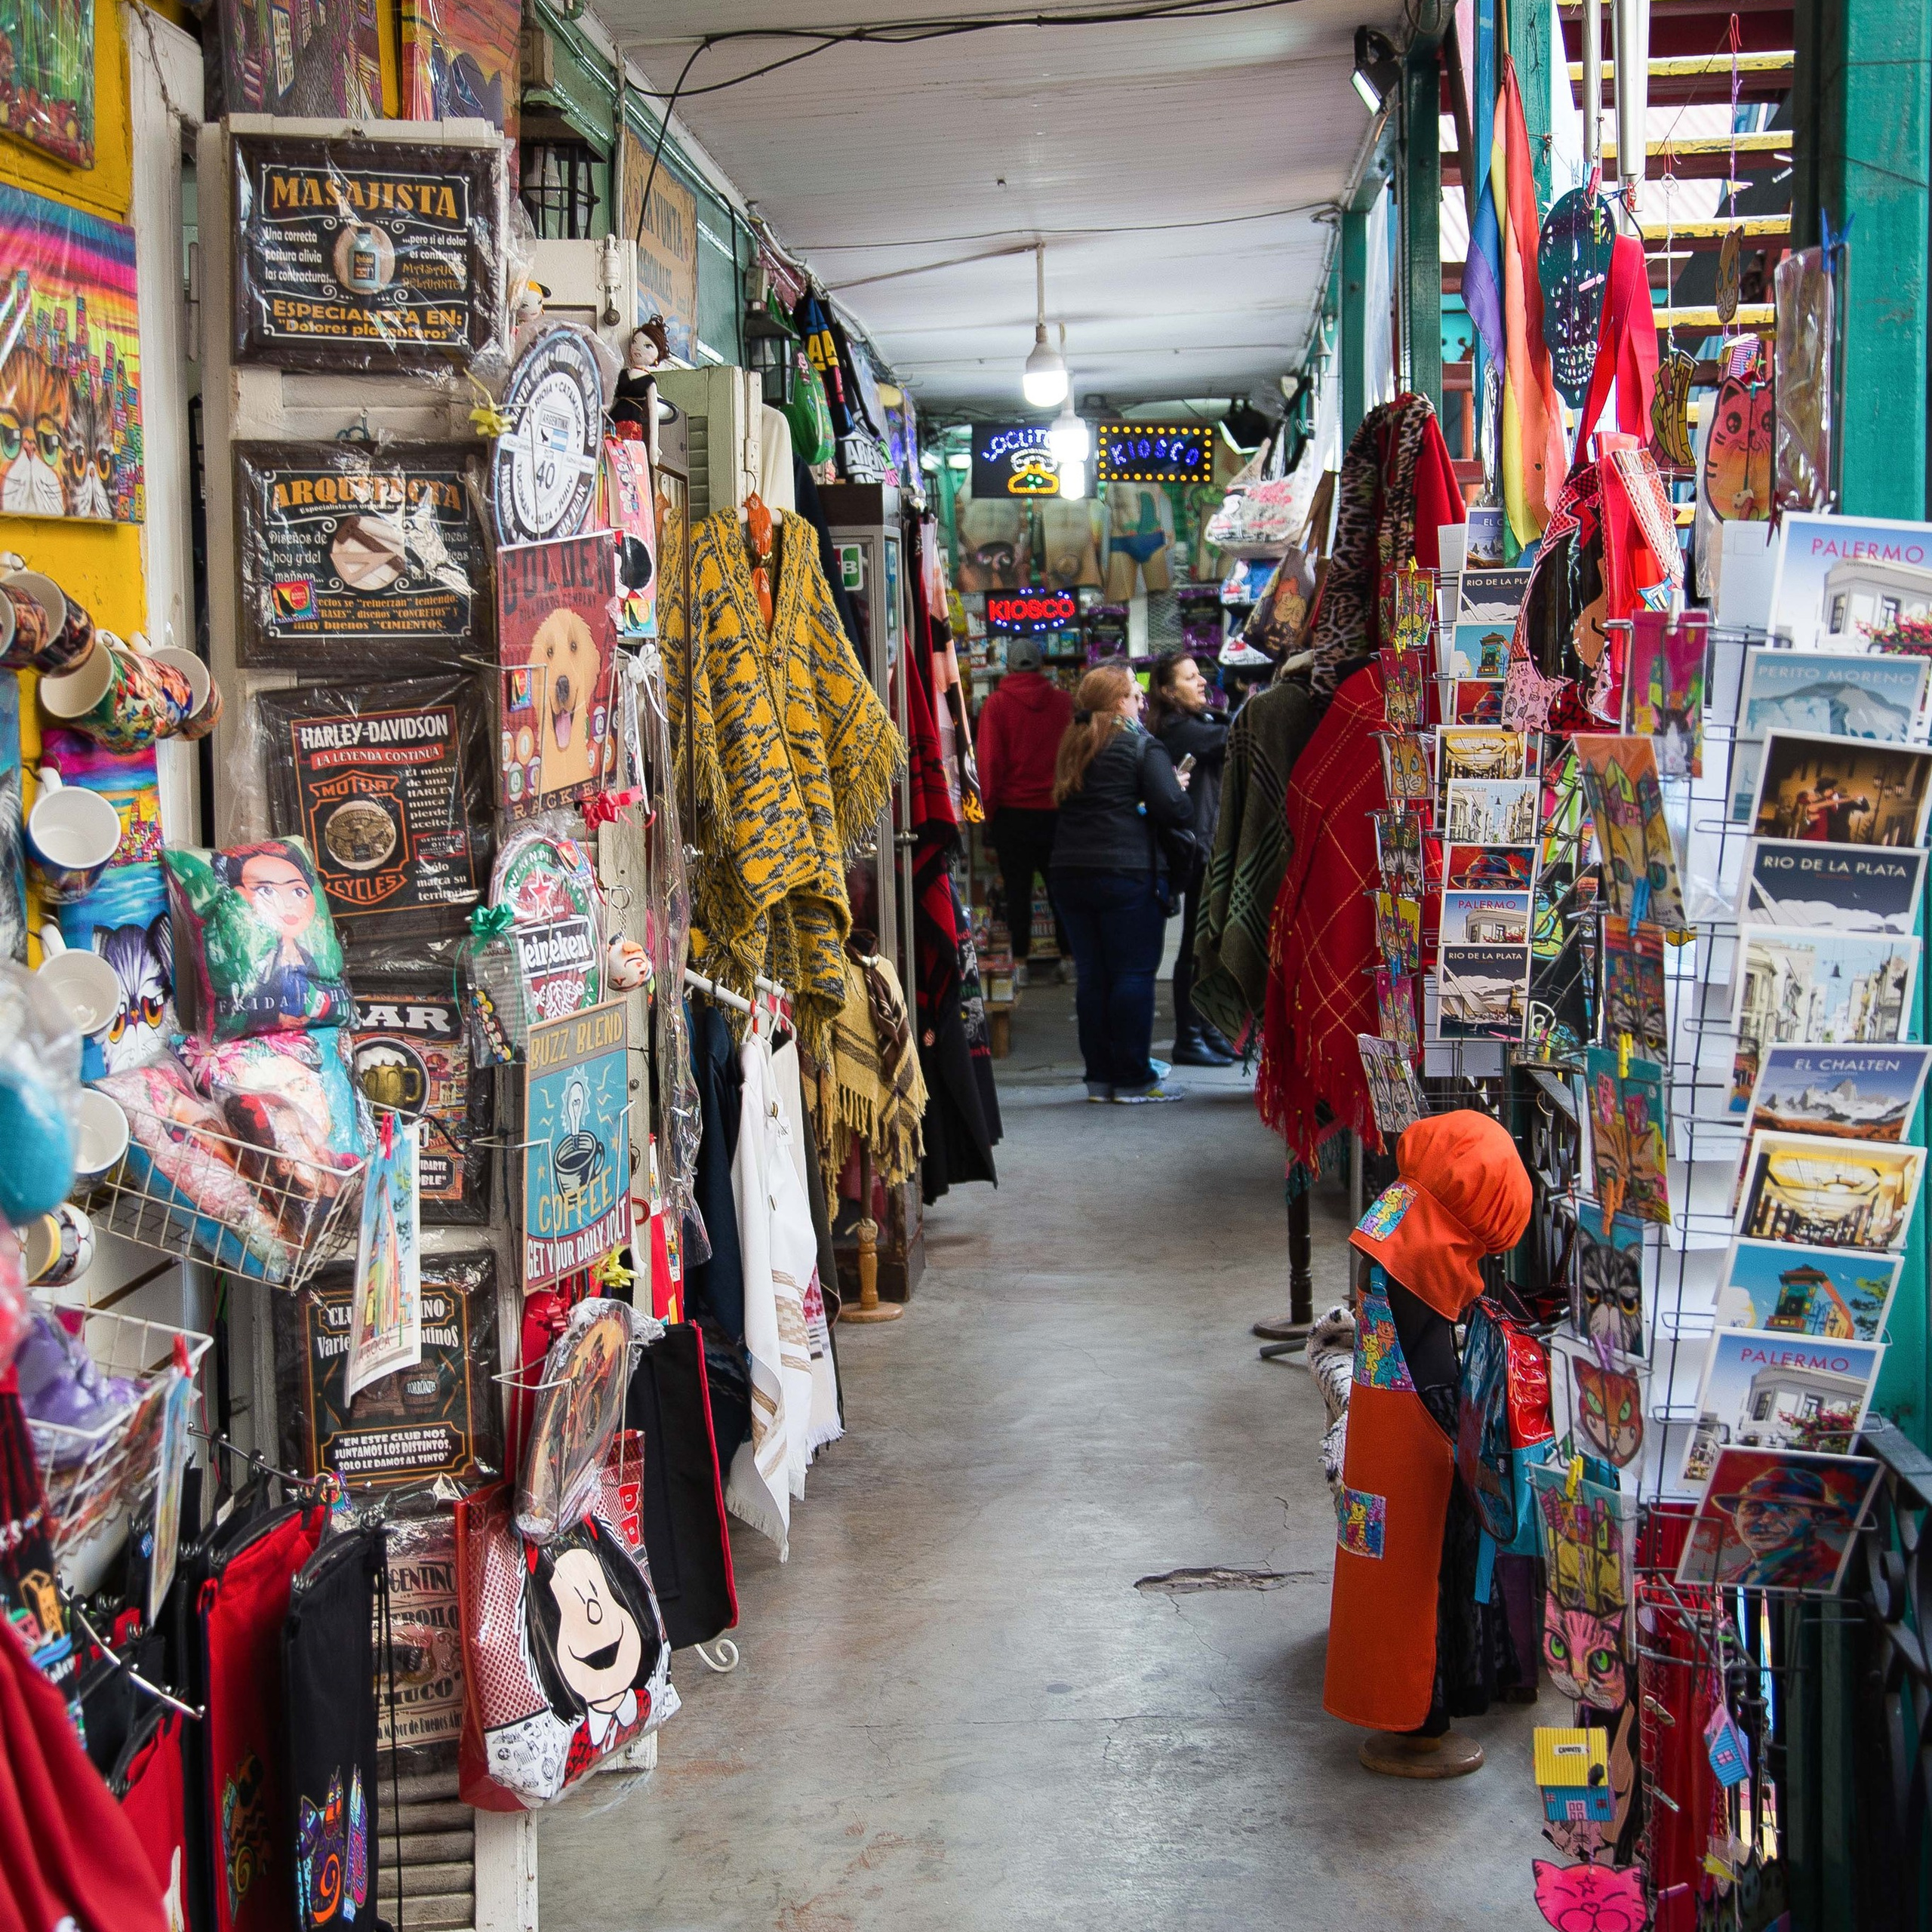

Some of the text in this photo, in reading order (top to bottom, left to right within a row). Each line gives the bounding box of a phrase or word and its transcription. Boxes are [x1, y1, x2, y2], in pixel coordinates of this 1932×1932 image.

[272, 176, 458, 220] MASAJISTA
[285, 229, 317, 243] correcta
[429, 235, 435, 245] si
[437, 235, 445, 246] el
[445, 235, 467, 248] dolor
[265, 247, 322, 263] postura alivia
[265, 266, 277, 281] las
[273, 300, 463, 326] ESPECIALISTA EN:
[278, 318, 346, 335] "Dolores
[537, 460, 555, 490] 40
[300, 503, 347, 515] Especialista
[1483, 518, 1494, 527] EL
[269, 531, 328, 545] Diseños de
[272, 550, 293, 568] hoy
[304, 549, 321, 565] del
[1811, 537, 1924, 564] PALERMO
[502, 536, 614, 616] GOLDEN
[1466, 579, 1483, 587] RIO
[1486, 578, 1499, 586] DE
[989, 598, 1075, 621] KIOSCO
[1758, 665, 1915, 684] PERITO MORENO
[301, 715, 449, 749] HARLEY-DAVIDSON
[317, 747, 440, 767] LA LEYENDA CONTINUA
[321, 774, 389, 796] MOTOR
[408, 786, 454, 798] HARLEY
[408, 798, 445, 808] nunca
[512, 789, 574, 820] RACK
[1763, 855, 1795, 869] RIO
[1801, 857, 1823, 872] DE
[1829, 860, 1849, 874] LA
[1856, 862, 1907, 878] PLATA
[333, 876, 397, 900] CYCLES
[453, 875, 467, 884] su
[1458, 900, 1516, 910] PALERMO
[1448, 952, 1524, 961] RIO DE LA PLATA
[219, 989, 349, 1014] FRIDA KHL
[530, 1011, 623, 1070] BUZZ BLEND
[1794, 1058, 1900, 1072] EL CHALTEN
[538, 1166, 614, 1233] COFFEE
[528, 1198, 627, 1281] GET YOUR DAILY JOLT
[1740, 1348, 1849, 1372] PALERMO
[339, 1429, 446, 1447] "EN ESTE CLUB NOS
[334, 1439, 451, 1459] JUNTAMOS LOS DISTINTOS,
[339, 1453, 448, 1471] SOLO LE DAMOS AL TINTO"
[409, 1719, 420, 1735] de
